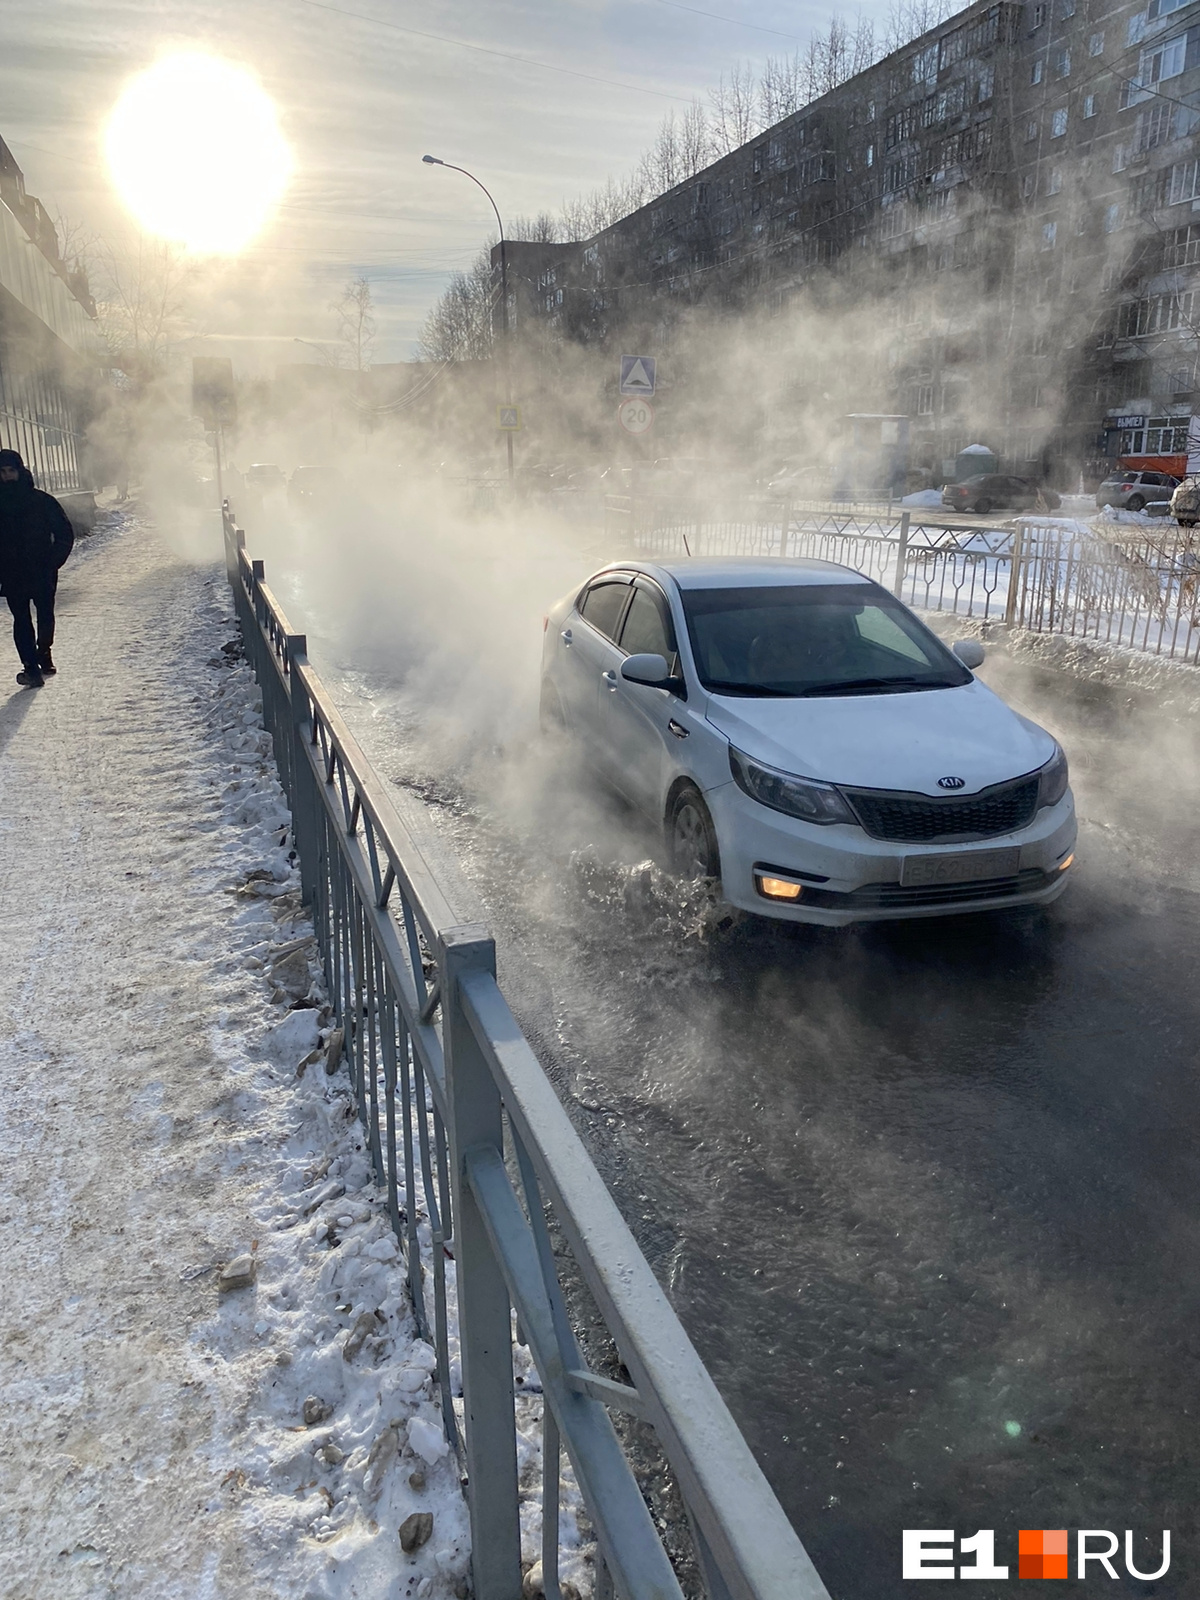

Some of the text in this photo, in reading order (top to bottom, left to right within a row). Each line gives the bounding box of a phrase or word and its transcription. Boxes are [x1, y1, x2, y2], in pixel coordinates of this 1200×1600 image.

[627, 408, 647, 424] 20
[1117, 416, 1143, 428] ВЫМПЕЛ
[940, 778, 963, 787] KIA
